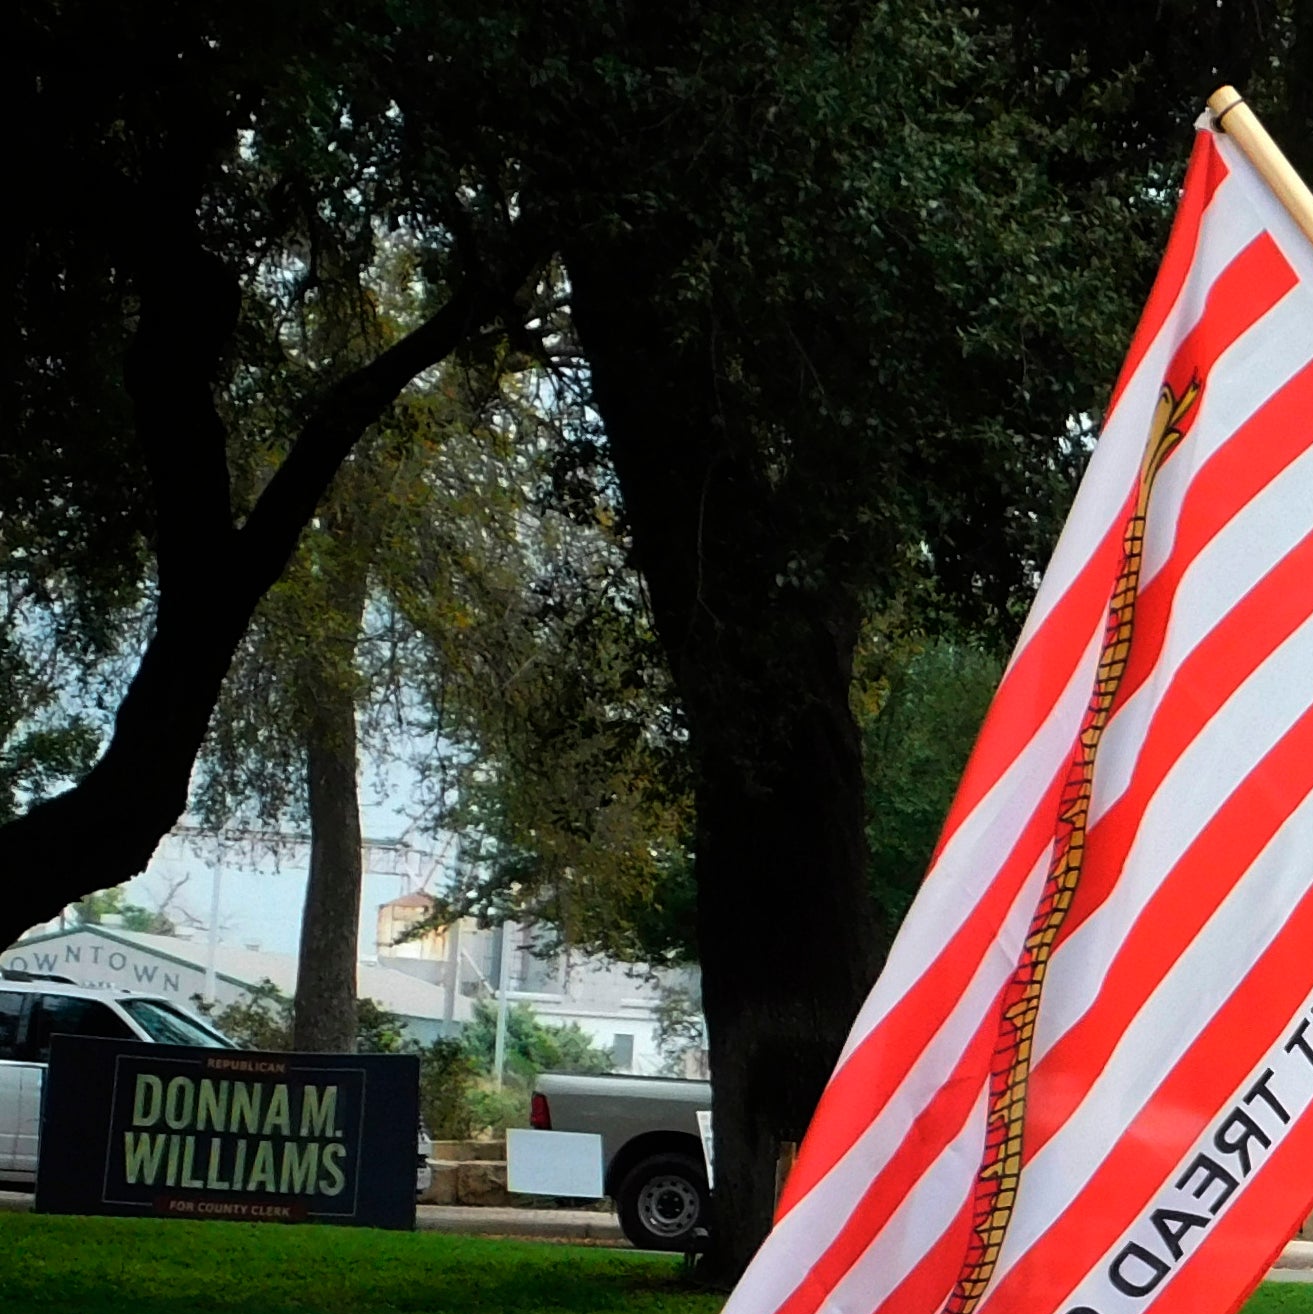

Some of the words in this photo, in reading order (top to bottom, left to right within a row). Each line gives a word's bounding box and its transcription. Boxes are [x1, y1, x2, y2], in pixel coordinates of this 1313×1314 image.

[10, 945, 180, 992] OWNTOWN
[207, 1057, 286, 1074] REPUBLICAN
[132, 1073, 291, 1136] DONNA
[300, 1085, 343, 1138] M.
[124, 1131, 347, 1197] WILLIAMS
[169, 1200, 194, 1212] FOR
[198, 1202, 248, 1215] COUNTY
[251, 1205, 291, 1217] CLERK
